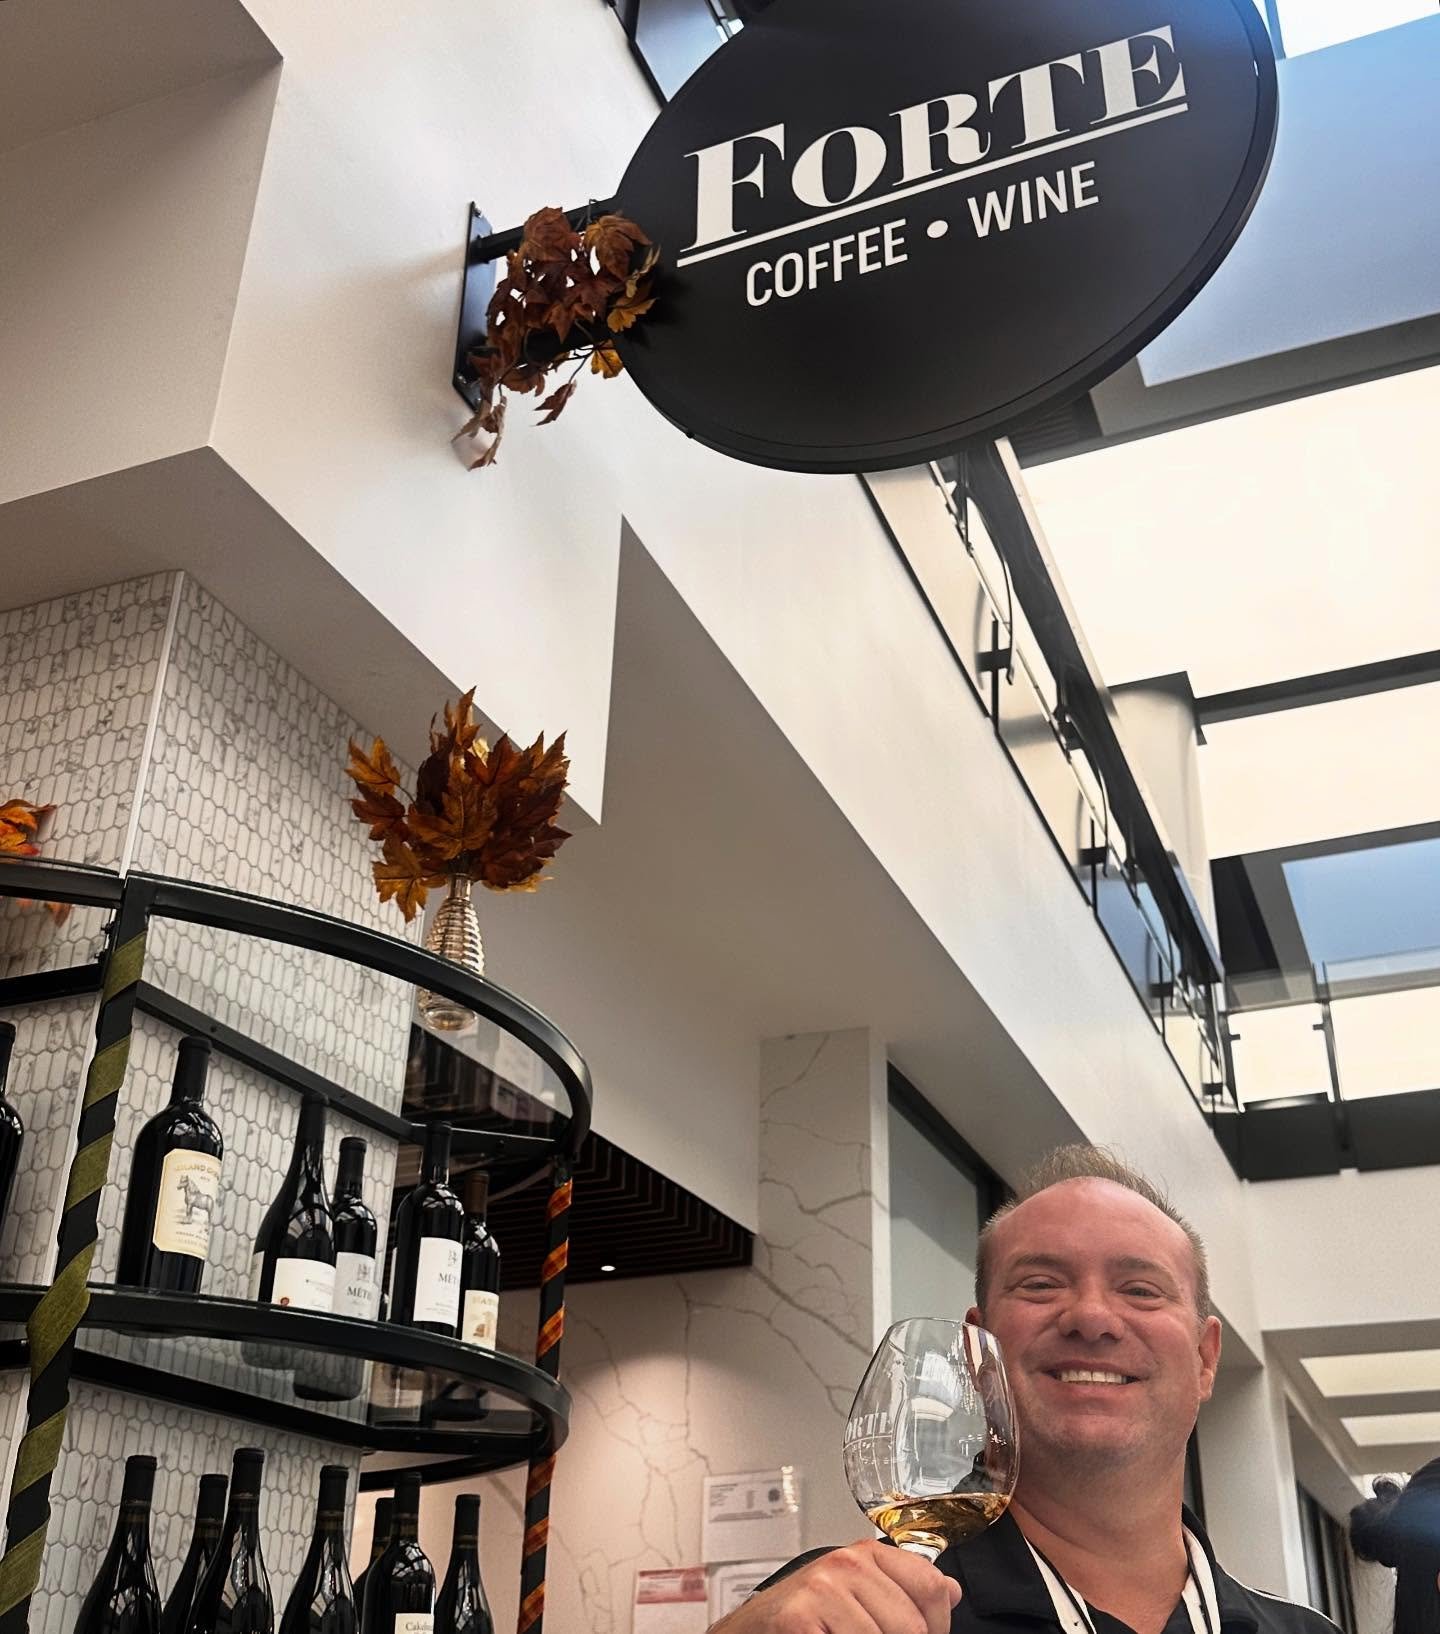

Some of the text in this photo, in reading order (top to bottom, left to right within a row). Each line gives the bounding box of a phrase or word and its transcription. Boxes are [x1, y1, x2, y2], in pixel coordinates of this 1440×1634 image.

[680, 25, 1186, 252] FORTE
[746, 161, 1098, 306] COFFEE WINE
